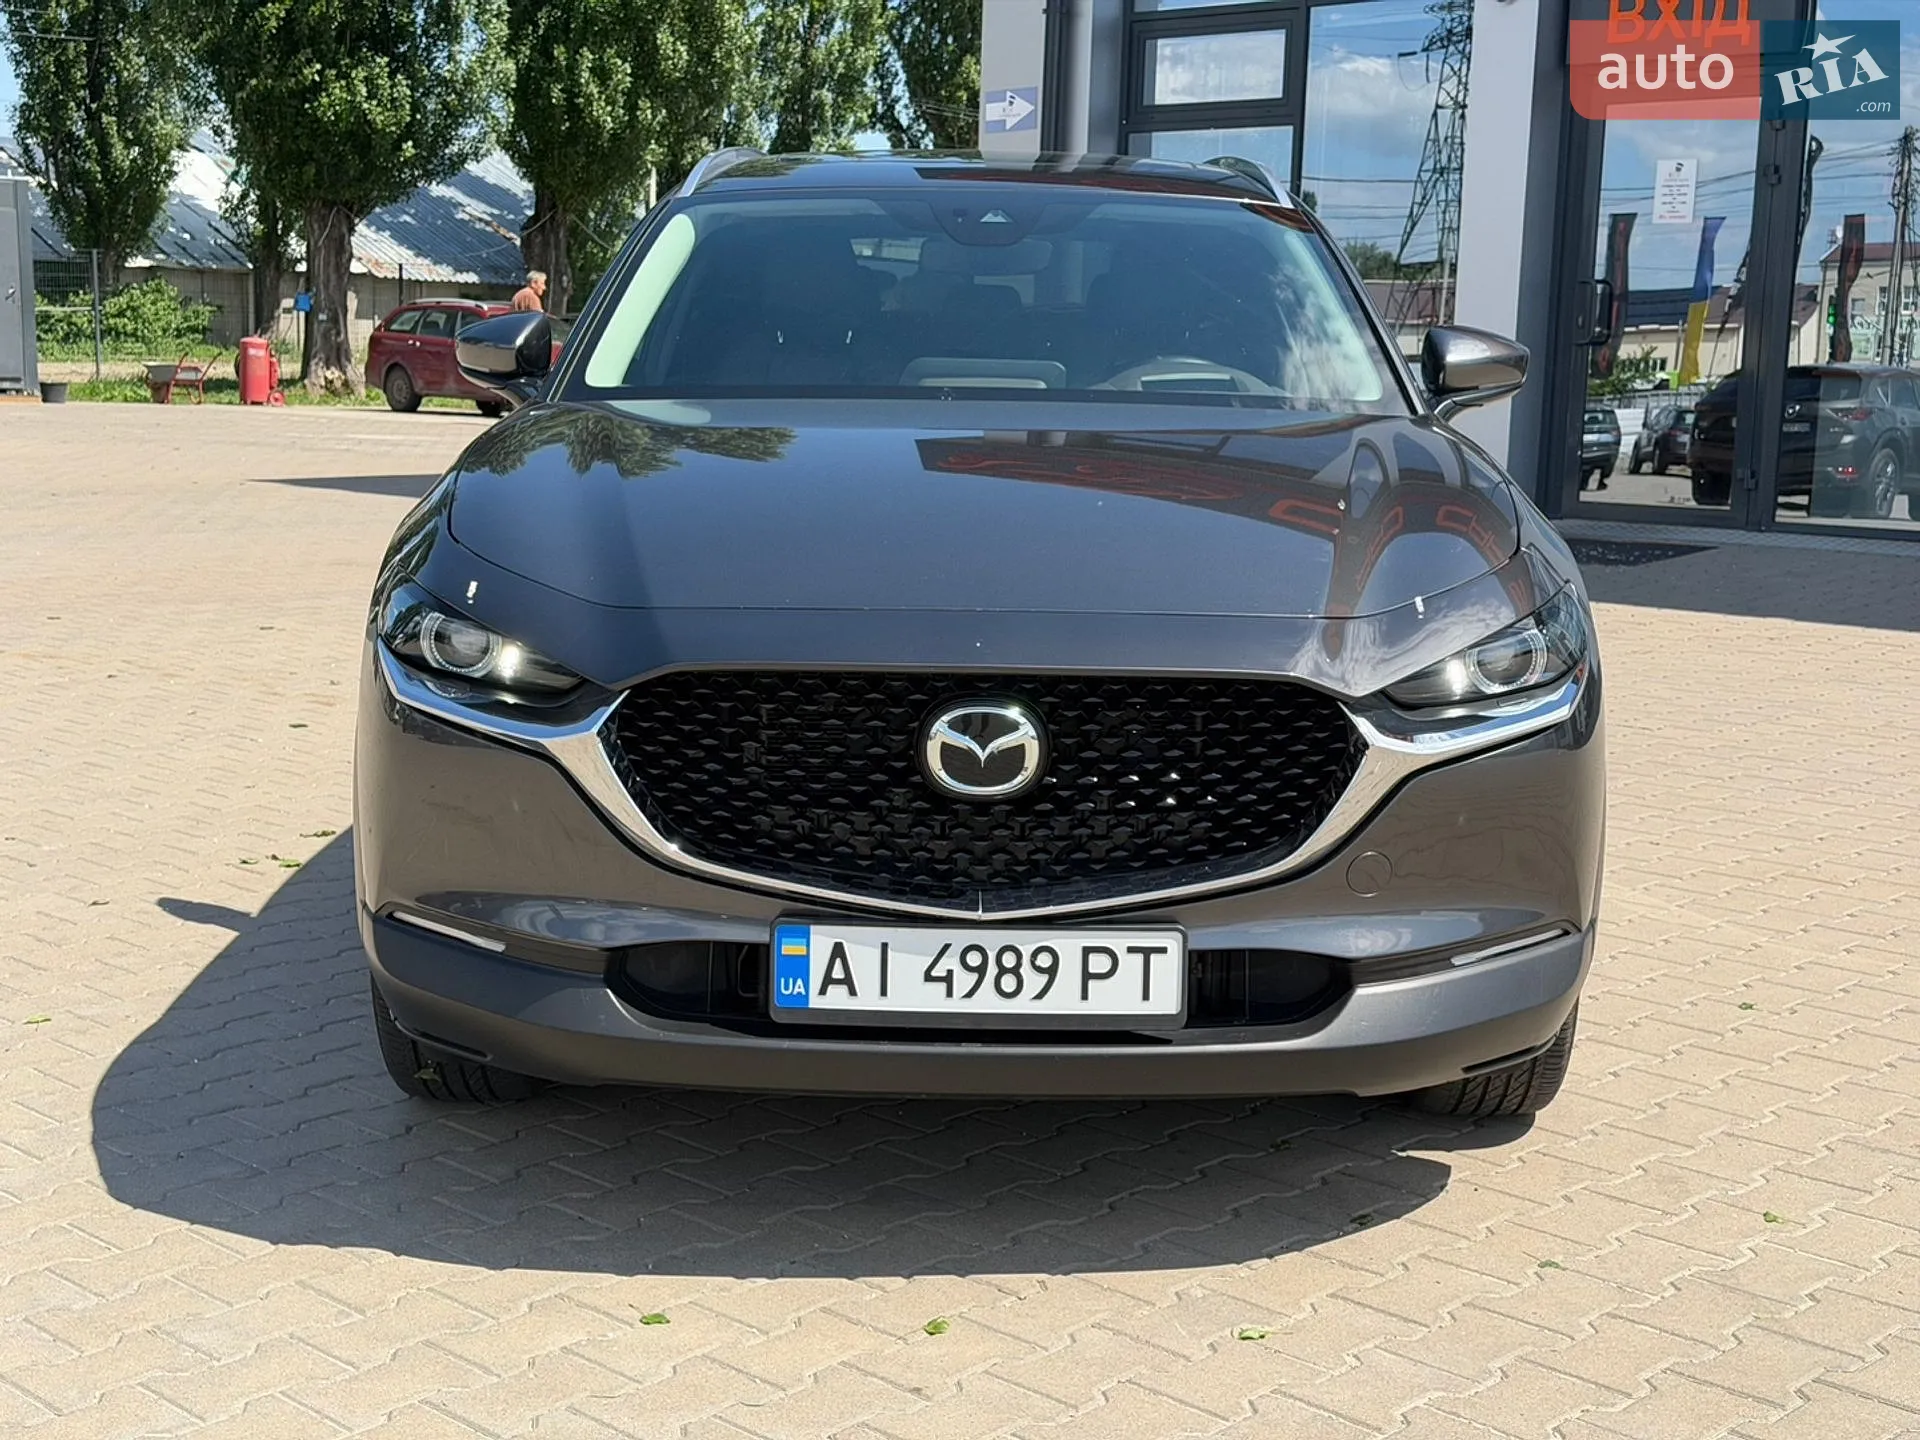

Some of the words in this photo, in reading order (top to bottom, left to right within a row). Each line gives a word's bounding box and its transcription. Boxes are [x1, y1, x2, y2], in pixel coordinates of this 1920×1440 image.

[1607, 0, 1750, 47] ВХІД
[780, 977, 806, 995] UA
[818, 941, 890, 998] AI
[923, 942, 1061, 1000] 4989
[1080, 946, 1168, 1002] PT
